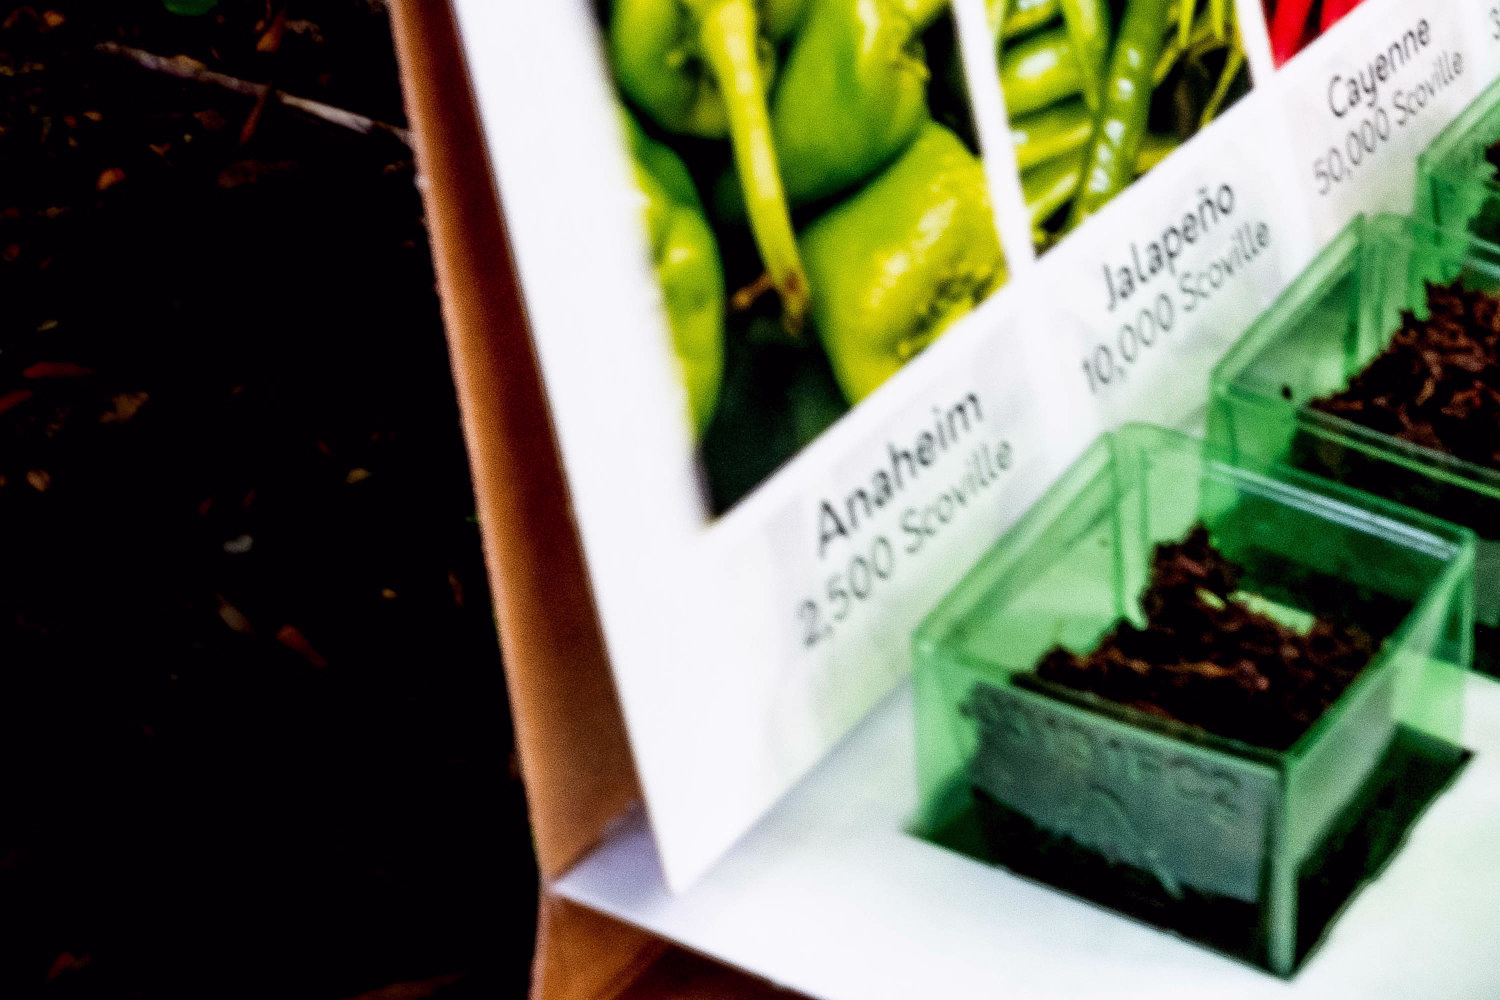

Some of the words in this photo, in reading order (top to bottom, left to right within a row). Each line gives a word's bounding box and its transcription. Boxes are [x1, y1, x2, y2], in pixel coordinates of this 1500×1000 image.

[1312, 106, 1391, 197] 50,000
[1392, 50, 1464, 127] Scoville
[1327, 18, 1431, 119] Cayenne
[1080, 292, 1175, 395] 10,000
[1177, 219, 1272, 314] Scoville
[1101, 182, 1236, 314] Jalapeño
[796, 535, 895, 650] 2,500
[900, 438, 1015, 557] Scoville
[816, 391, 985, 560] Anaheim
